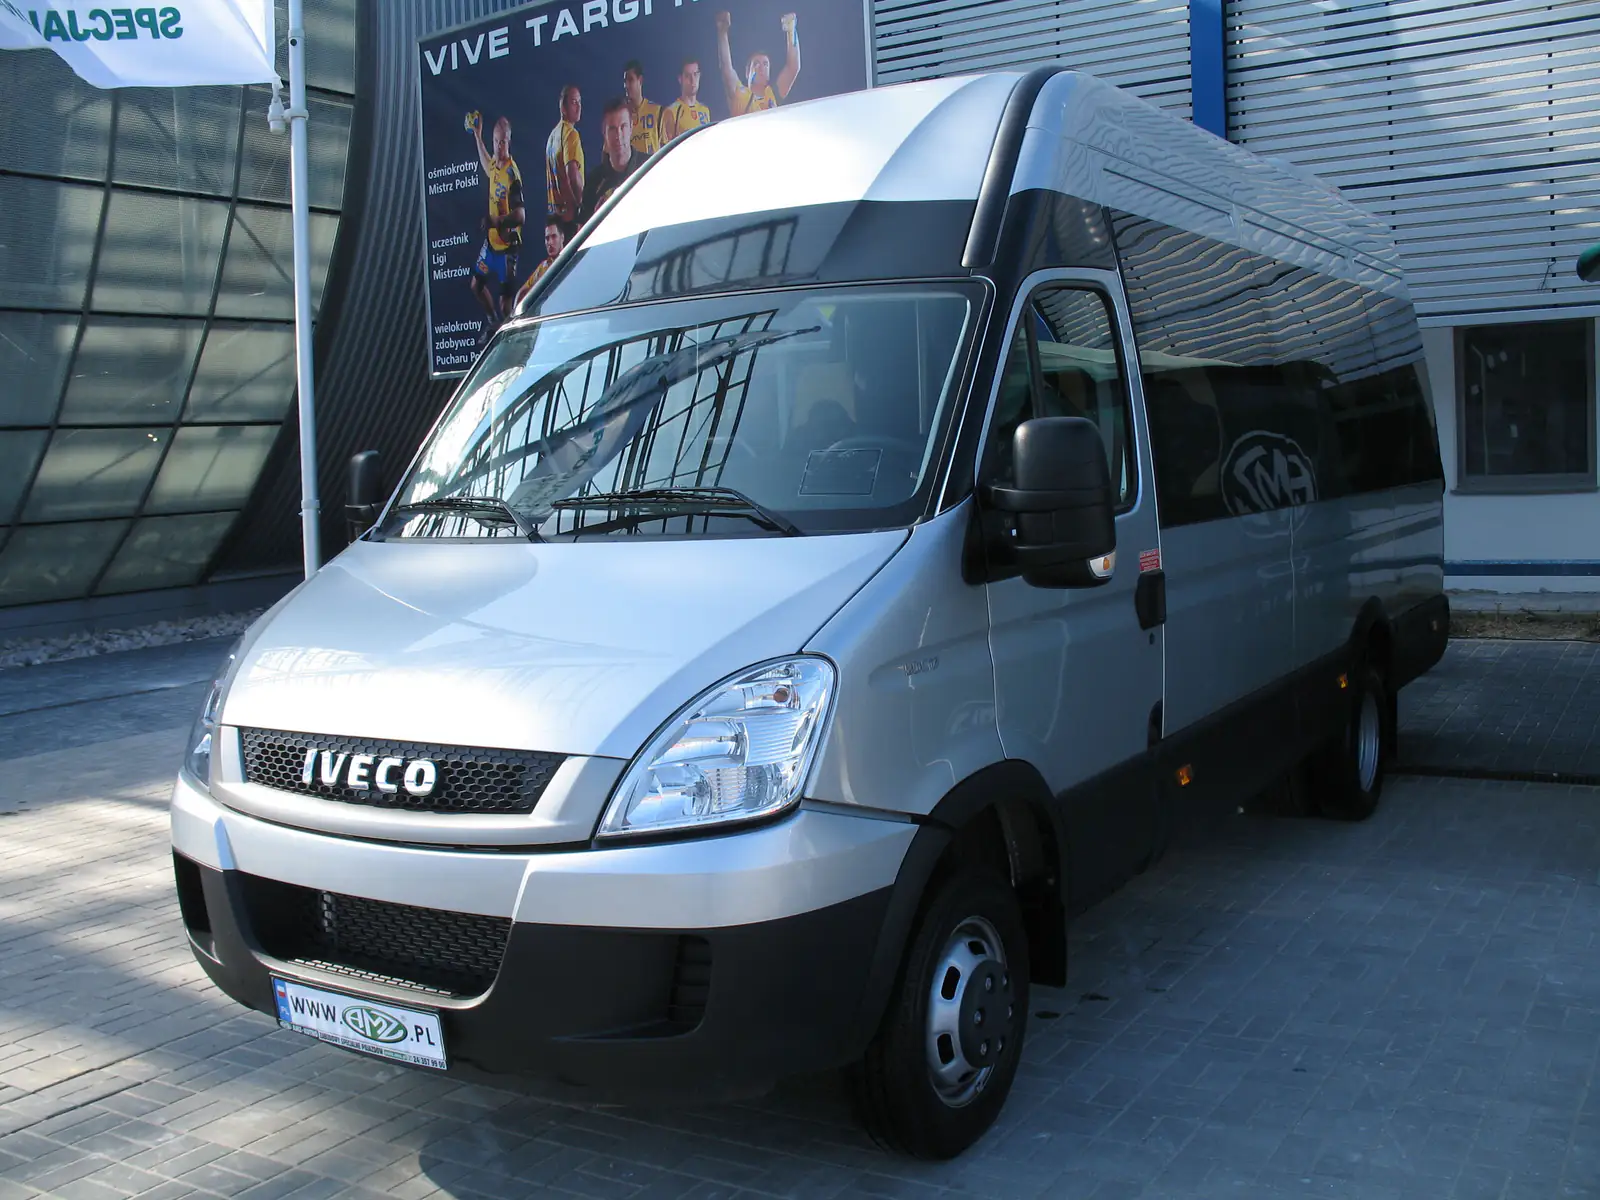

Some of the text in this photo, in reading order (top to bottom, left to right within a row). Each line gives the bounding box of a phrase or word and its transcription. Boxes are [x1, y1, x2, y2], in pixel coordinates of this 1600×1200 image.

[424, 26, 509, 76] VIVE
[640, 113, 654, 129] 10
[428, 160, 479, 180] ośmiokrotny
[428, 174, 479, 195] Mistrz Polski
[432, 232, 469, 249] uczestnik
[432, 252, 447, 266] Ligi
[433, 266, 471, 280] Mistrzów
[434, 320, 482, 334] wielokrotny
[435, 337, 476, 351] zdobywca
[436, 353, 468, 366] Pucharu
[302, 748, 437, 797] IVECO
